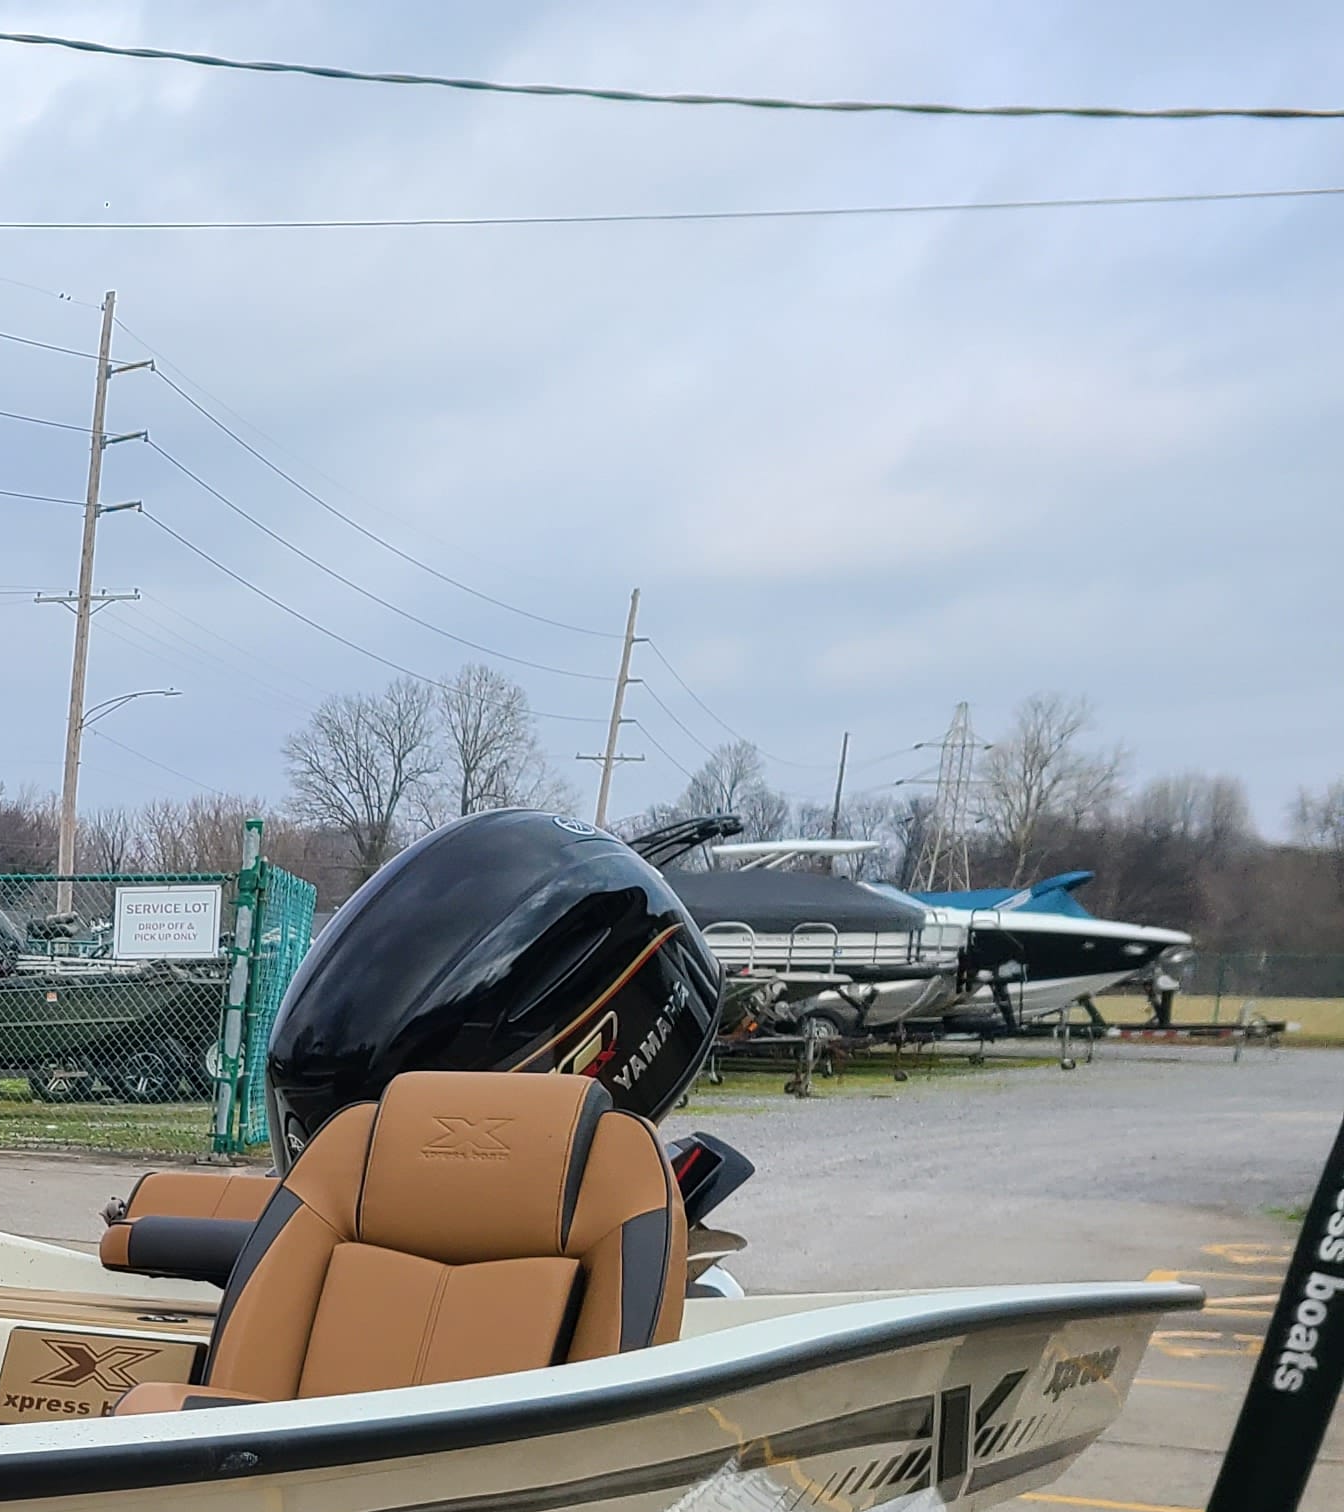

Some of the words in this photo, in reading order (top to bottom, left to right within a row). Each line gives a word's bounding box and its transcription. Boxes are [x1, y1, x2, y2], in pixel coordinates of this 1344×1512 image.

[126, 903, 181, 914] SERVICE
[184, 903, 209, 913] LOT
[138, 922, 165, 930] DROP
[167, 922, 184, 930] OFF
[187, 922, 195, 930] &
[134, 933, 157, 941] PICK
[158, 933, 172, 941] UP
[173, 933, 198, 941] ONLY
[1273, 1271, 1344, 1392] boats
[3, 1391, 90, 1415] xpress
